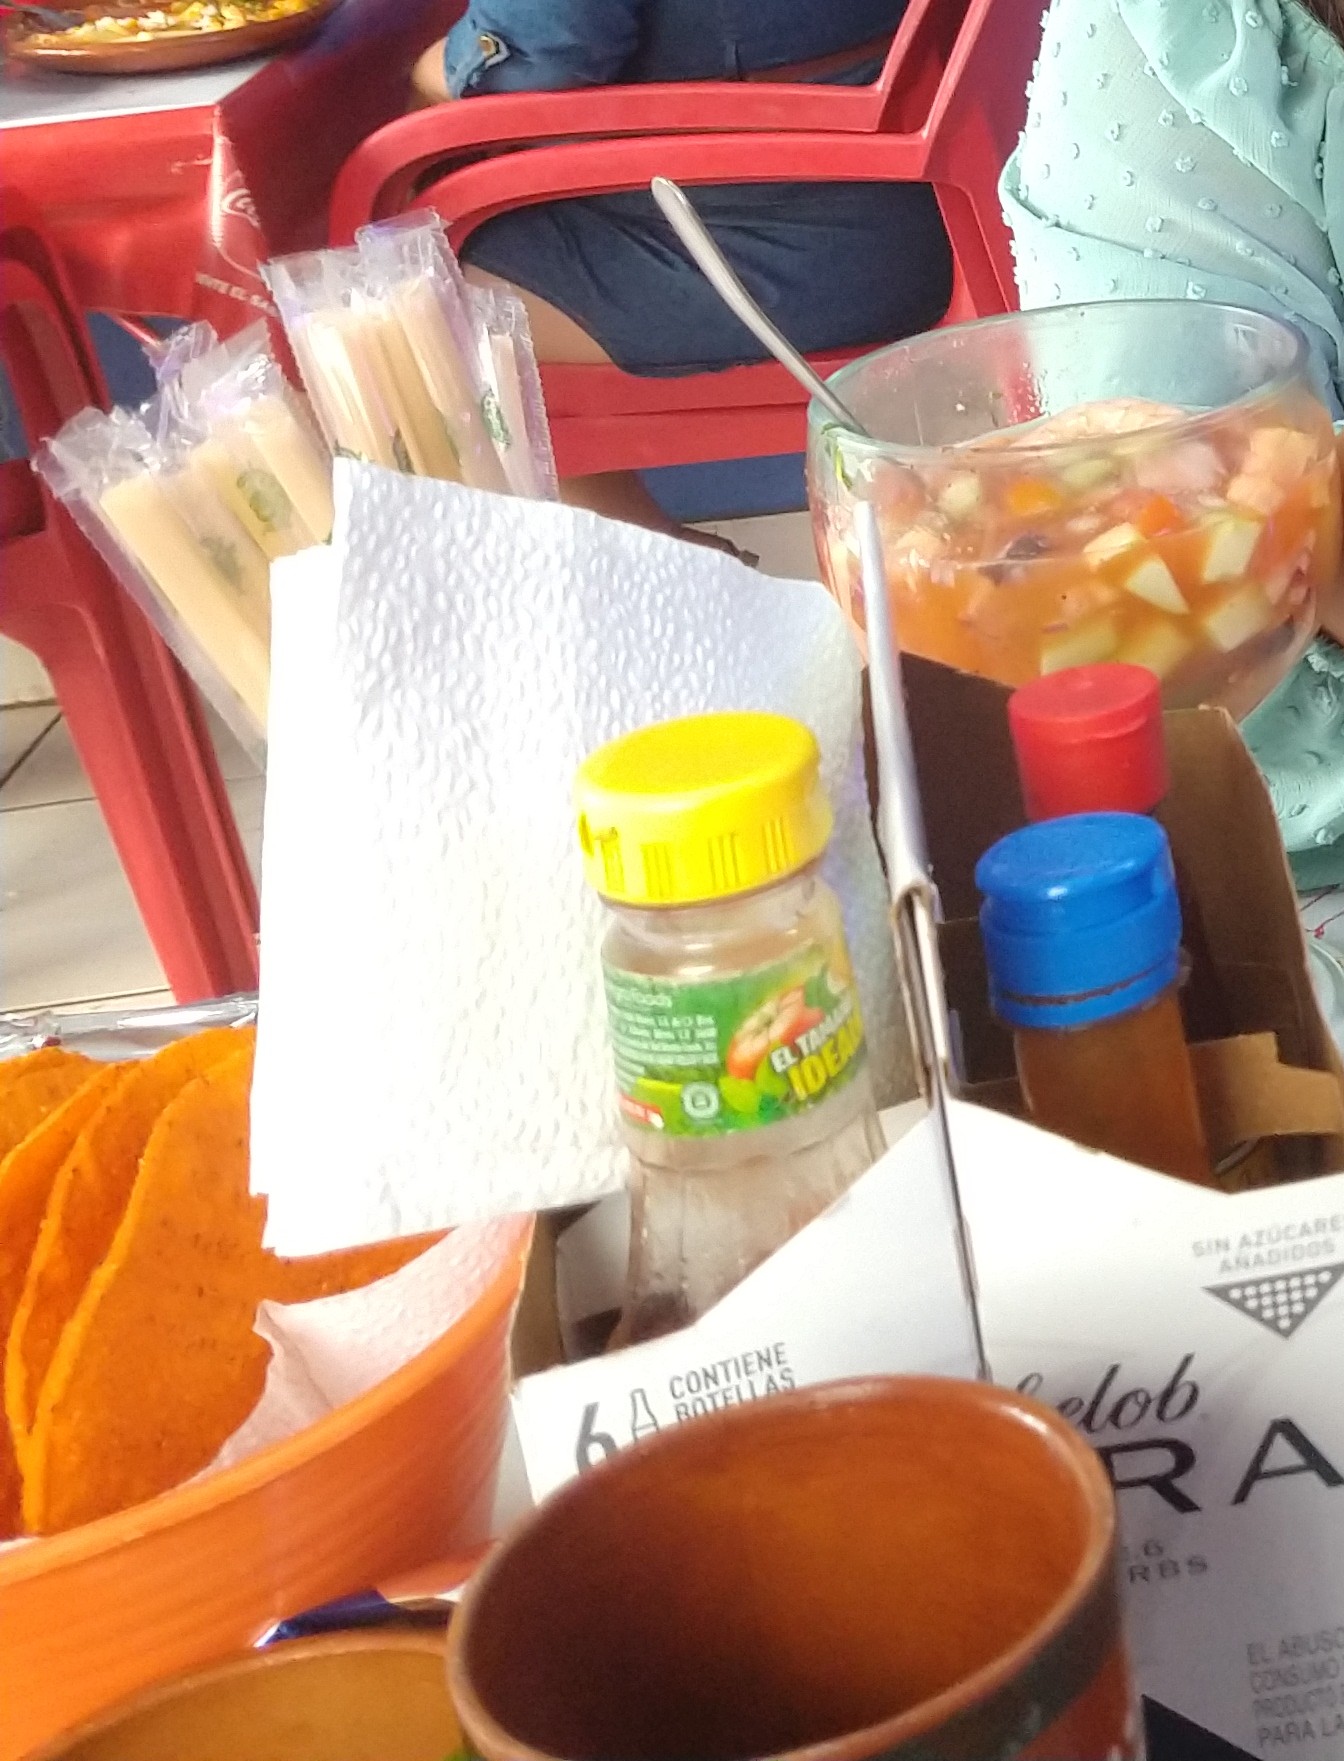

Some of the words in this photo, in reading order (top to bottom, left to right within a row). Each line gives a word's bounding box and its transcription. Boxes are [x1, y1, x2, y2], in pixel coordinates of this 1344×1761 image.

[771, 1046, 798, 1073] EL
[1192, 1238, 1231, 1257] SIN
[1219, 1237, 1336, 1274] AÑADIDOS
[669, 1342, 788, 1400] CONTIENE
[1017, 1352, 1200, 1434] elob
[576, 1401, 617, 1475] 6
[1128, 1555, 1208, 1583] RBS
[1247, 1642, 1271, 1665] EL
[1251, 1656, 1340, 1694] CONSUMO
[1257, 1718, 1316, 1748] PARA
